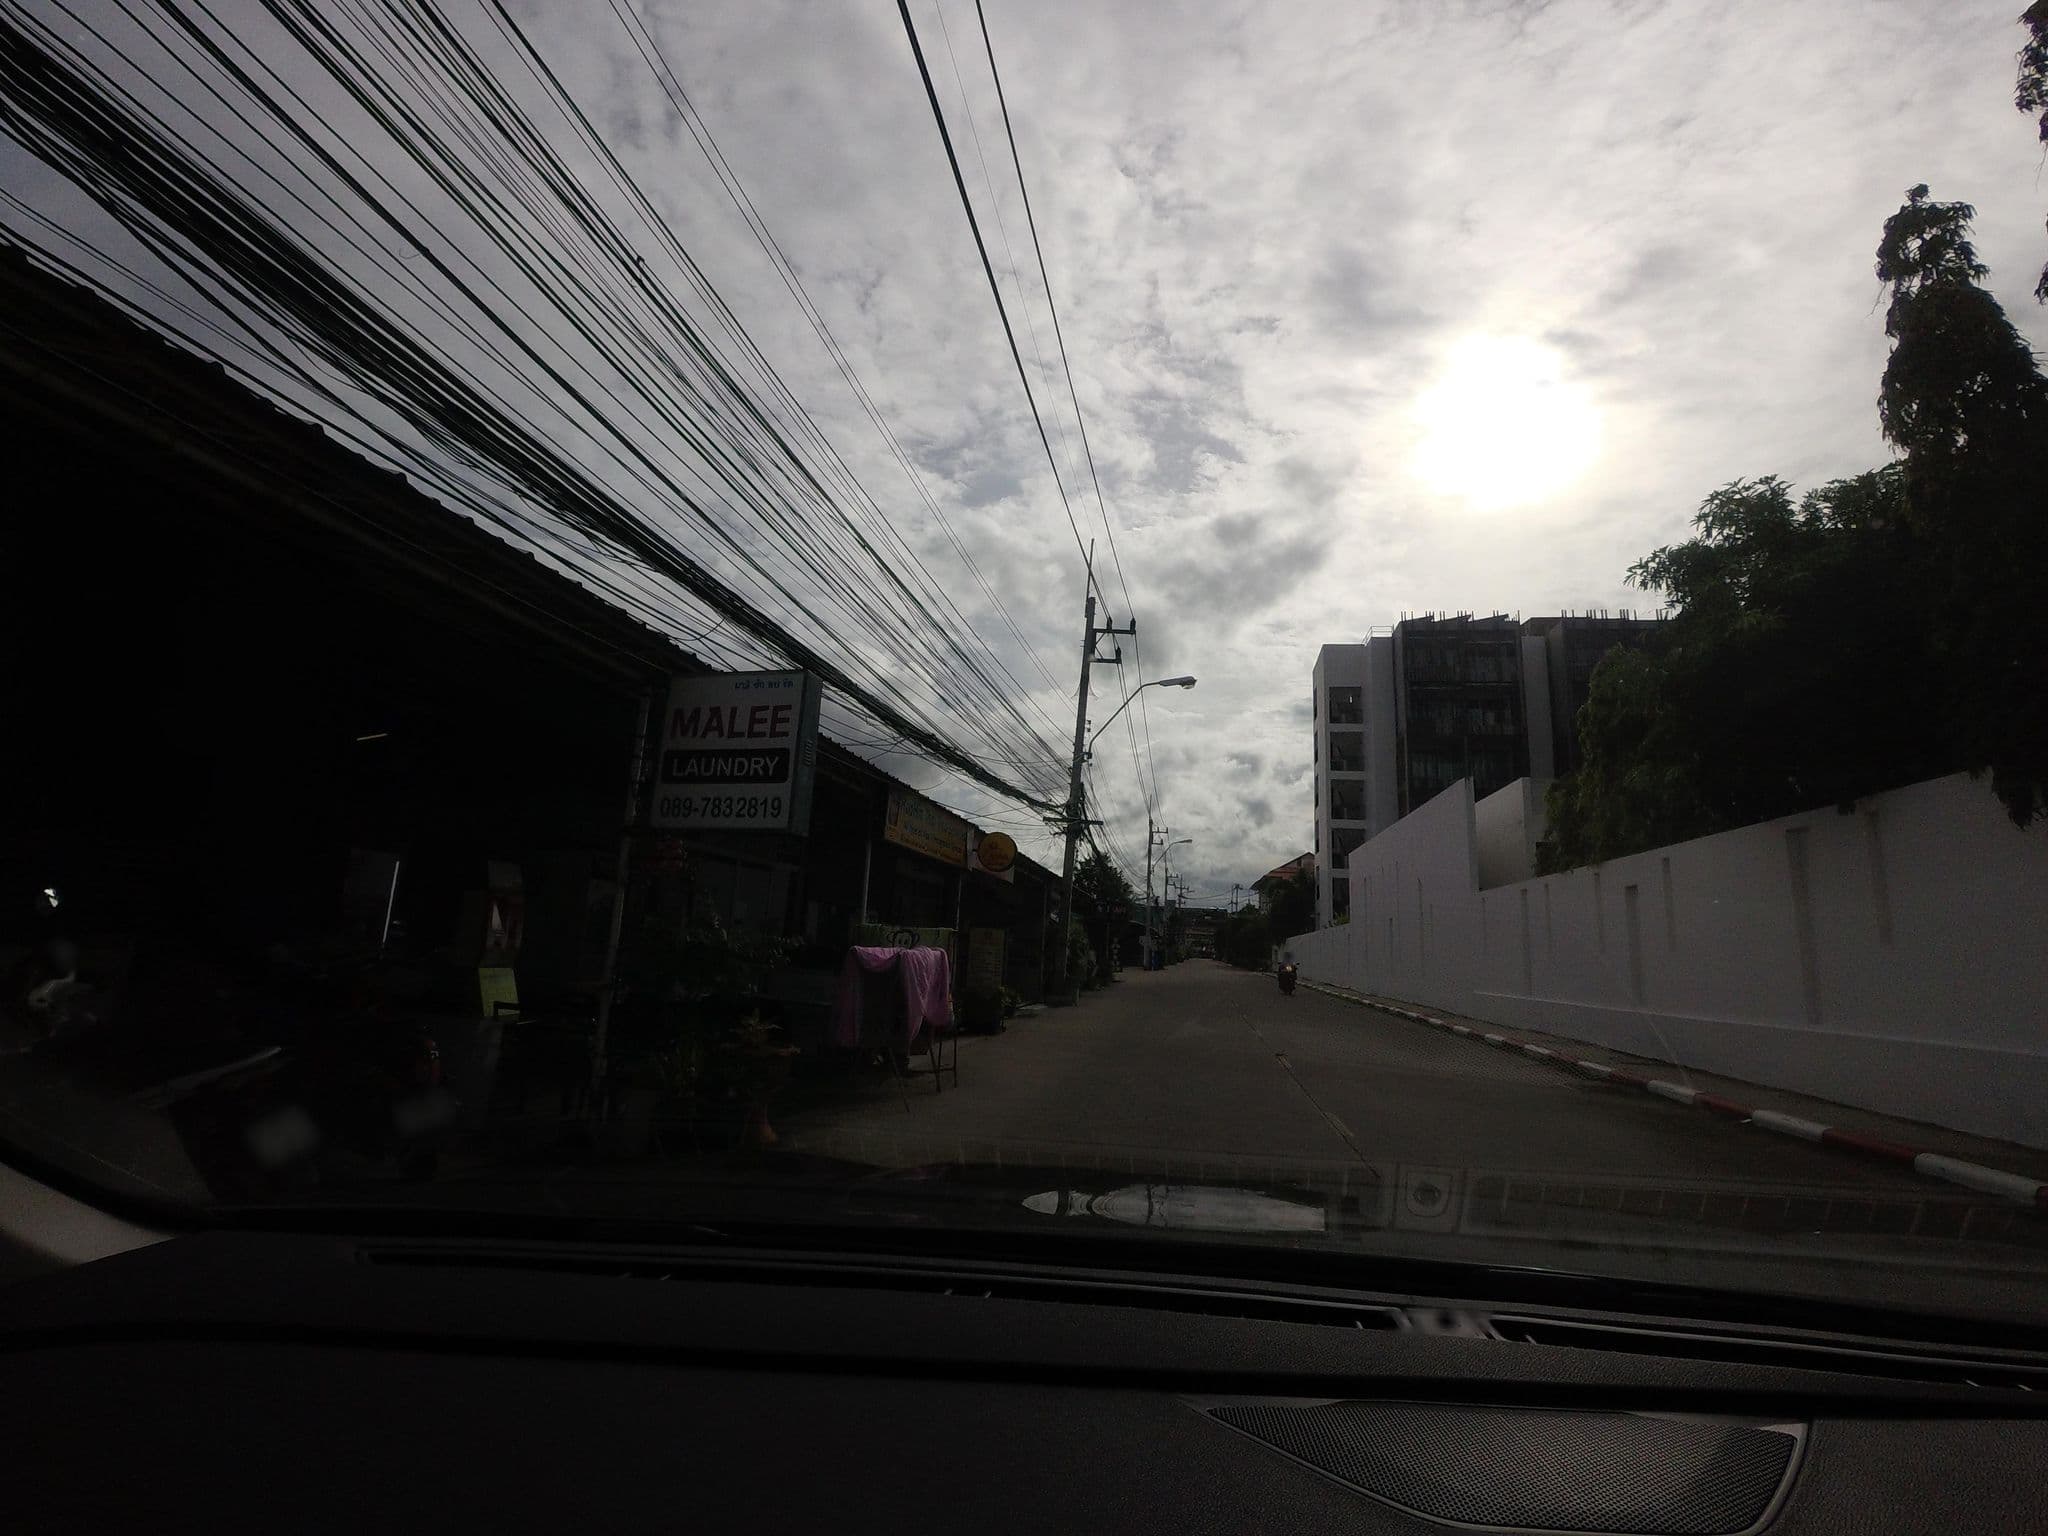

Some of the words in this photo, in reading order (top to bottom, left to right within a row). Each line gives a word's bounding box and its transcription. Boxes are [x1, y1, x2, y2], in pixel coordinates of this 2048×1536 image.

[672, 704, 793, 738] MALEE
[672, 756, 780, 777] LAUNDRY
[660, 796, 782, 818] 089-7832819
